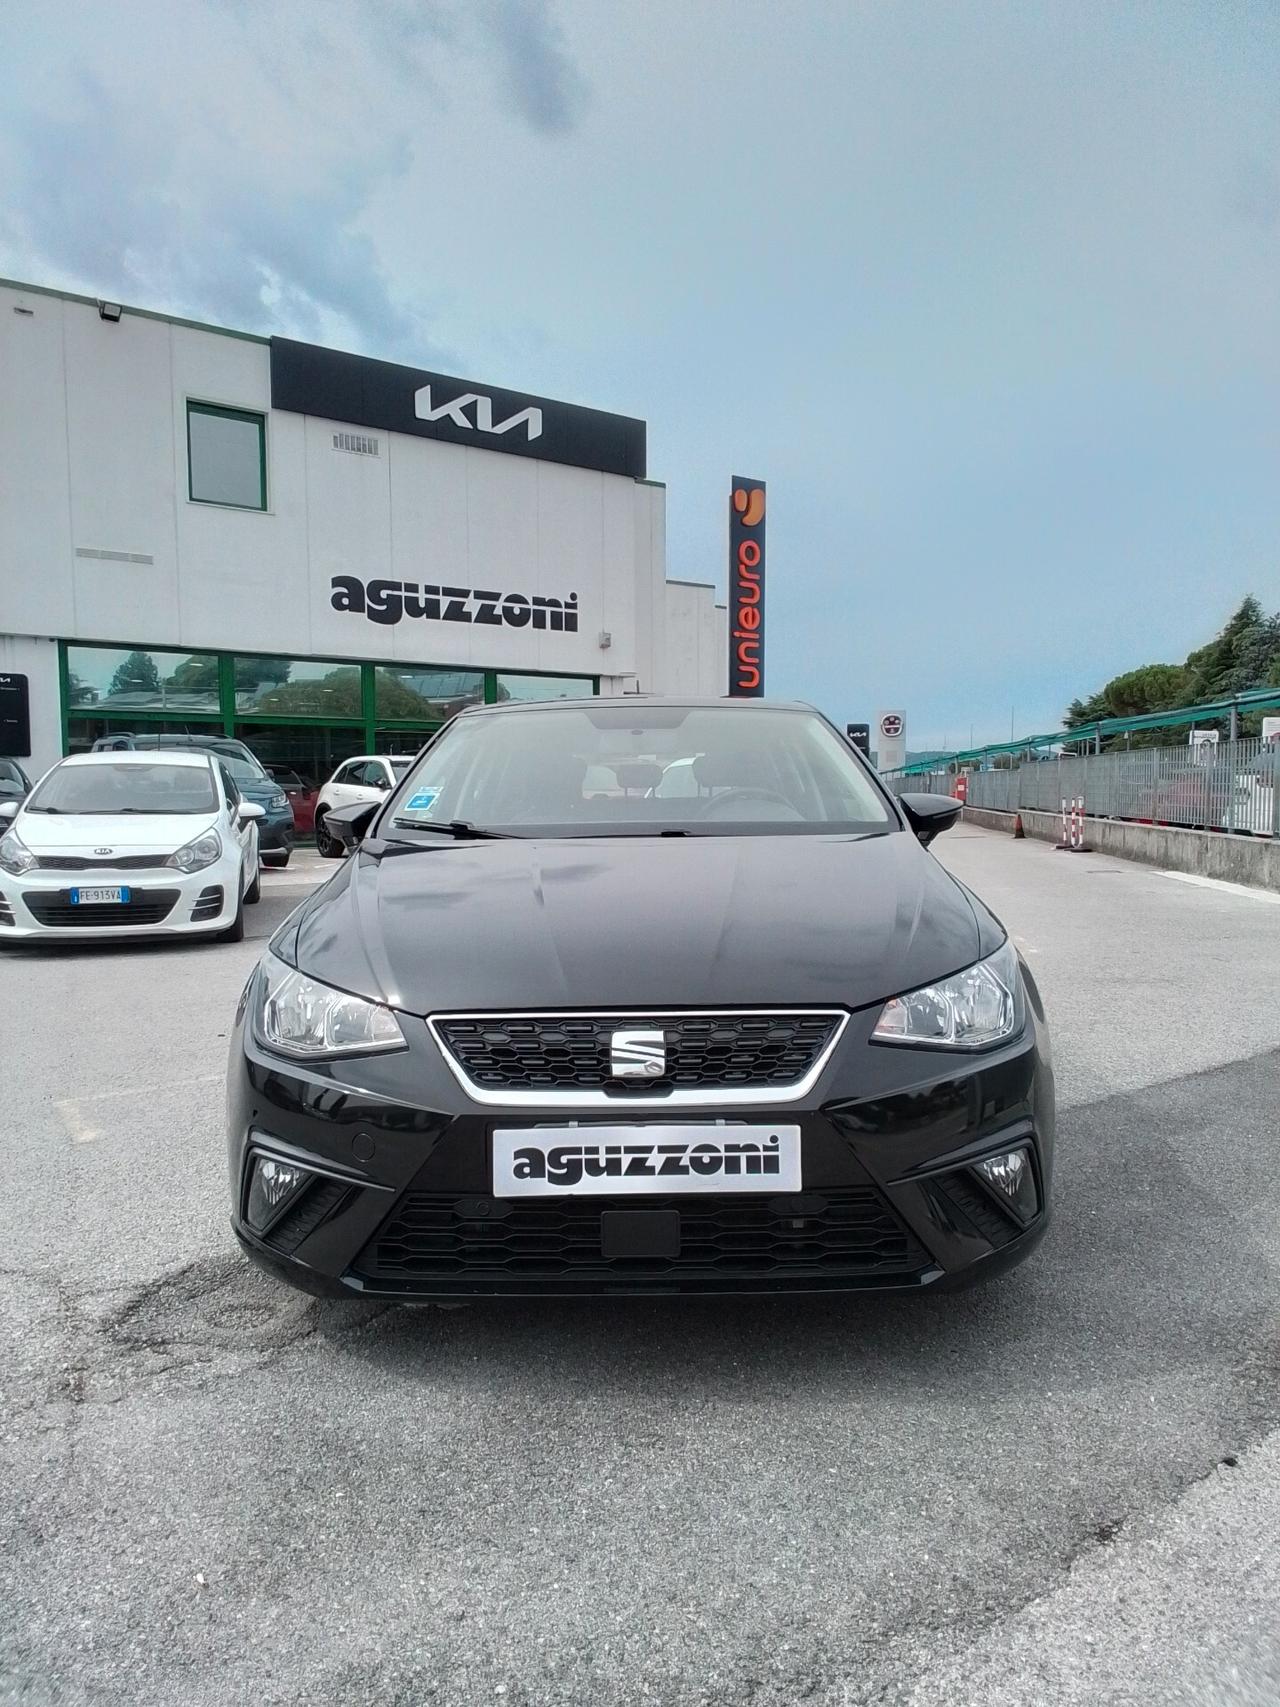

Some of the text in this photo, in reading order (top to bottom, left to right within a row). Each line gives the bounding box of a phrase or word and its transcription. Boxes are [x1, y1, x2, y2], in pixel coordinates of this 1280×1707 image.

[330, 575, 579, 632] aguzzoni
[733, 539, 761, 688] unieuro
[512, 1134, 780, 1186] aguzzoni
